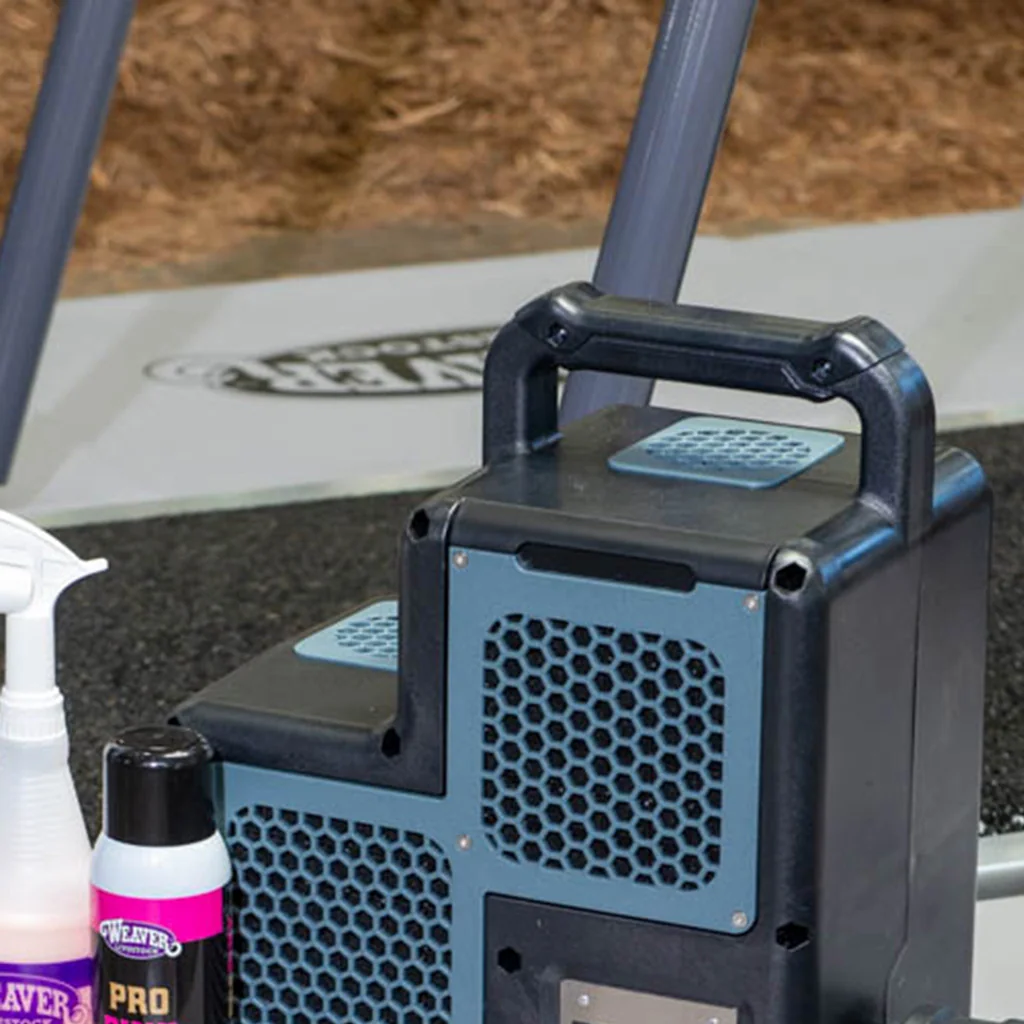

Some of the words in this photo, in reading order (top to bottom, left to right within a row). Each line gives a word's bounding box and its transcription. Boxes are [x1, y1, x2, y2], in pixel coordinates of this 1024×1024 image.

[100, 919, 170, 952] WEAVER
[0, 982, 70, 1019] AVER
[109, 981, 169, 1015] PRO
